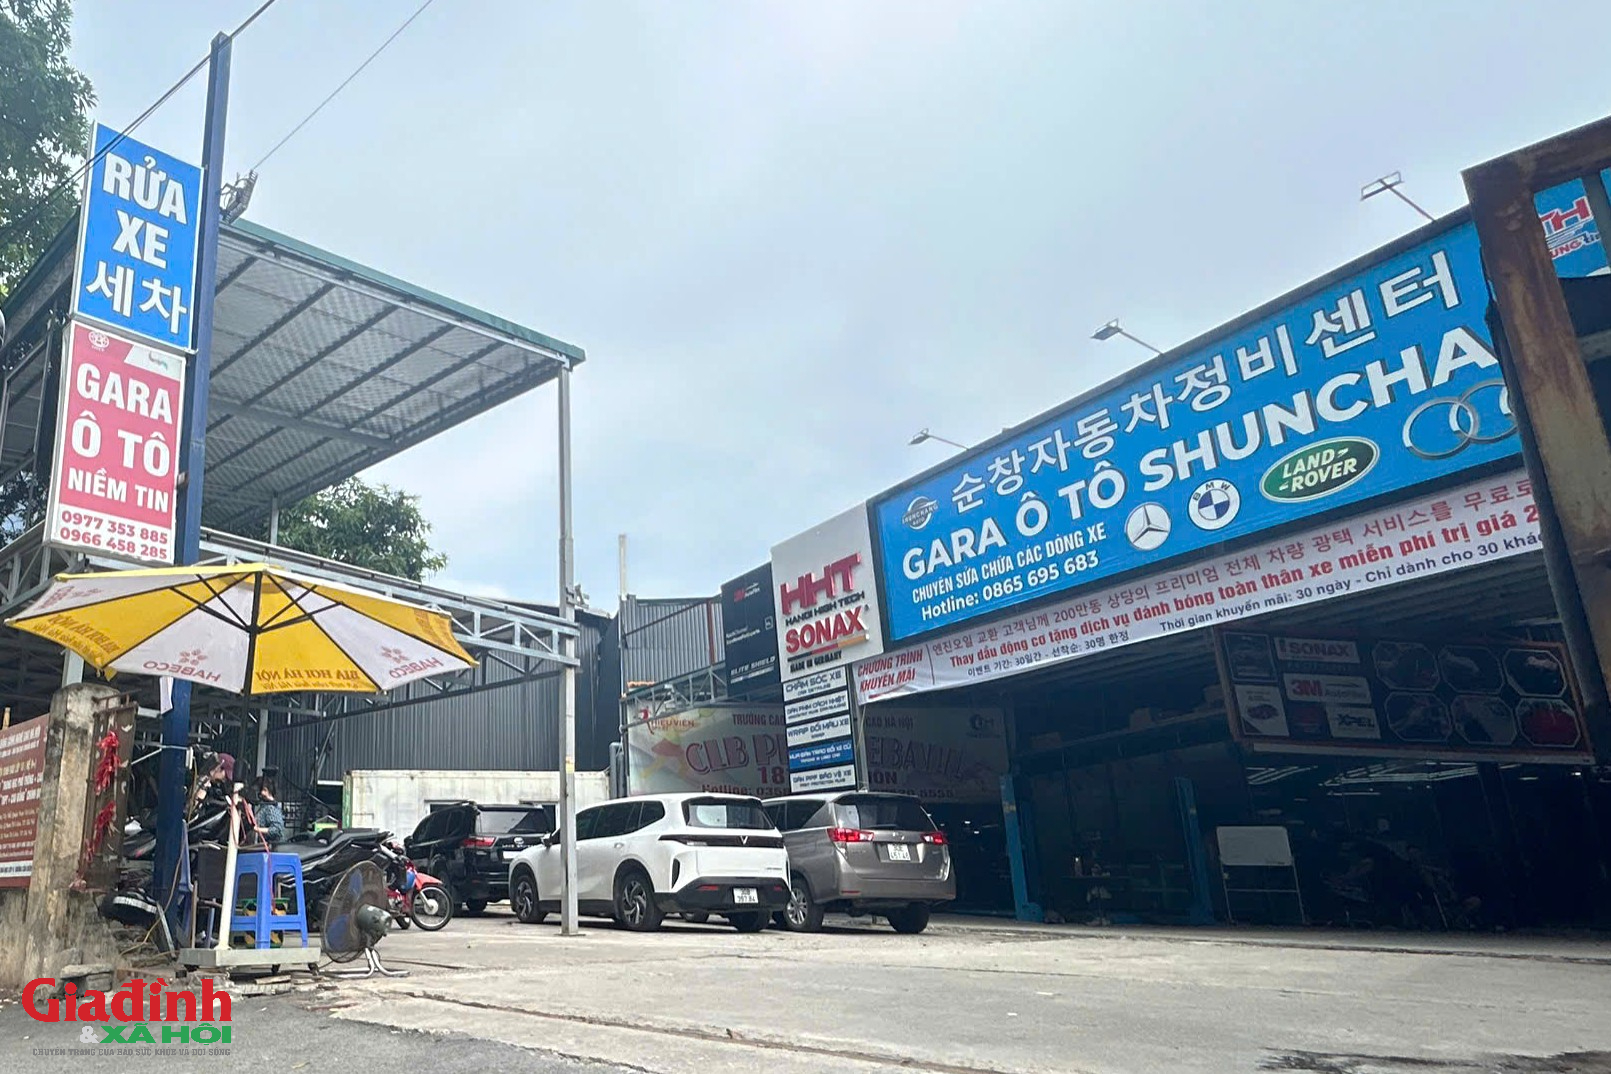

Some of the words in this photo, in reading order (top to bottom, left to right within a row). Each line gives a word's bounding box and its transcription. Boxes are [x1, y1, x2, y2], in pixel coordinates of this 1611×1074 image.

[102, 155, 187, 225] RỬA
[112, 209, 168, 269] XE
[86, 259, 188, 335] 세차
[77, 363, 173, 425] GARA
[71, 410, 101, 458] Ô
[117, 429, 170, 477] TÔ
[68, 467, 127, 503] NIỀM
[134, 484, 169, 513] TIN
[902, 517, 1007, 580] GARA
[1016, 491, 1048, 537] Ô
[1058, 460, 1126, 520] TÔ
[1193, 481, 1231, 501] BMW
[60, 527, 102, 546] 0966
[106, 538, 136, 554] 458
[140, 544, 167, 560] 285
[61, 511, 103, 530] 0977
[107, 520, 135, 538] 353
[140, 528, 168, 545] 885
[780, 553, 861, 615] HHT
[912, 578, 954, 604] CHUYÊN
[956, 565, 979, 589] SỬA
[981, 555, 1015, 581] CHỮA
[1017, 543, 1043, 568] CÁC
[1046, 530, 1084, 558] DÒNG
[1086, 521, 1107, 545] XE
[921, 594, 979, 622] Hotline:
[983, 575, 1023, 601] 0865
[1027, 563, 1060, 587] 695
[1064, 550, 1099, 575] 683
[950, 652, 975, 669] Thay
[1000, 638, 1029, 656] động
[1032, 632, 1047, 646] cơ
[1048, 627, 1078, 646] tặng
[1080, 616, 1110, 638] dịch
[1113, 613, 1130, 630] vụ
[1134, 601, 1171, 622] đánh
[1174, 590, 1215, 613] bóng
[1218, 578, 1258, 600] toàn
[1261, 566, 1304, 590] thân
[1309, 560, 1334, 578] xe
[1339, 543, 1394, 570] miễn
[1399, 530, 1436, 558] phí
[1441, 522, 1470, 545] trị
[1476, 509, 1517, 537] giá
[978, 628, 999, 646] 교환
[1053, 598, 1102, 624] 200만동
[1107, 585, 1150, 609] 상당의
[1155, 565, 1221, 596] 프리미엄
[1226, 553, 1262, 577] 전체
[1269, 542, 1306, 565] 차량
[1362, 500, 1453, 539] 서비스를
[1159, 618, 1185, 633] Thời
[1188, 612, 1213, 628] gian
[1215, 600, 1260, 622] khuyến
[1296, 588, 1313, 601] 30
[1316, 579, 1351, 597] ngày
[1365, 566, 1393, 584] Chỉ
[1396, 558, 1437, 577] dành
[1441, 550, 1473, 566] cho
[1477, 542, 1499, 557] 30
[786, 605, 864, 653] SONAX
[814, 601, 837, 616] HIGH
[838, 591, 866, 607] TECH
[830, 670, 842, 680] XE
[686, 736, 749, 776] CLB
